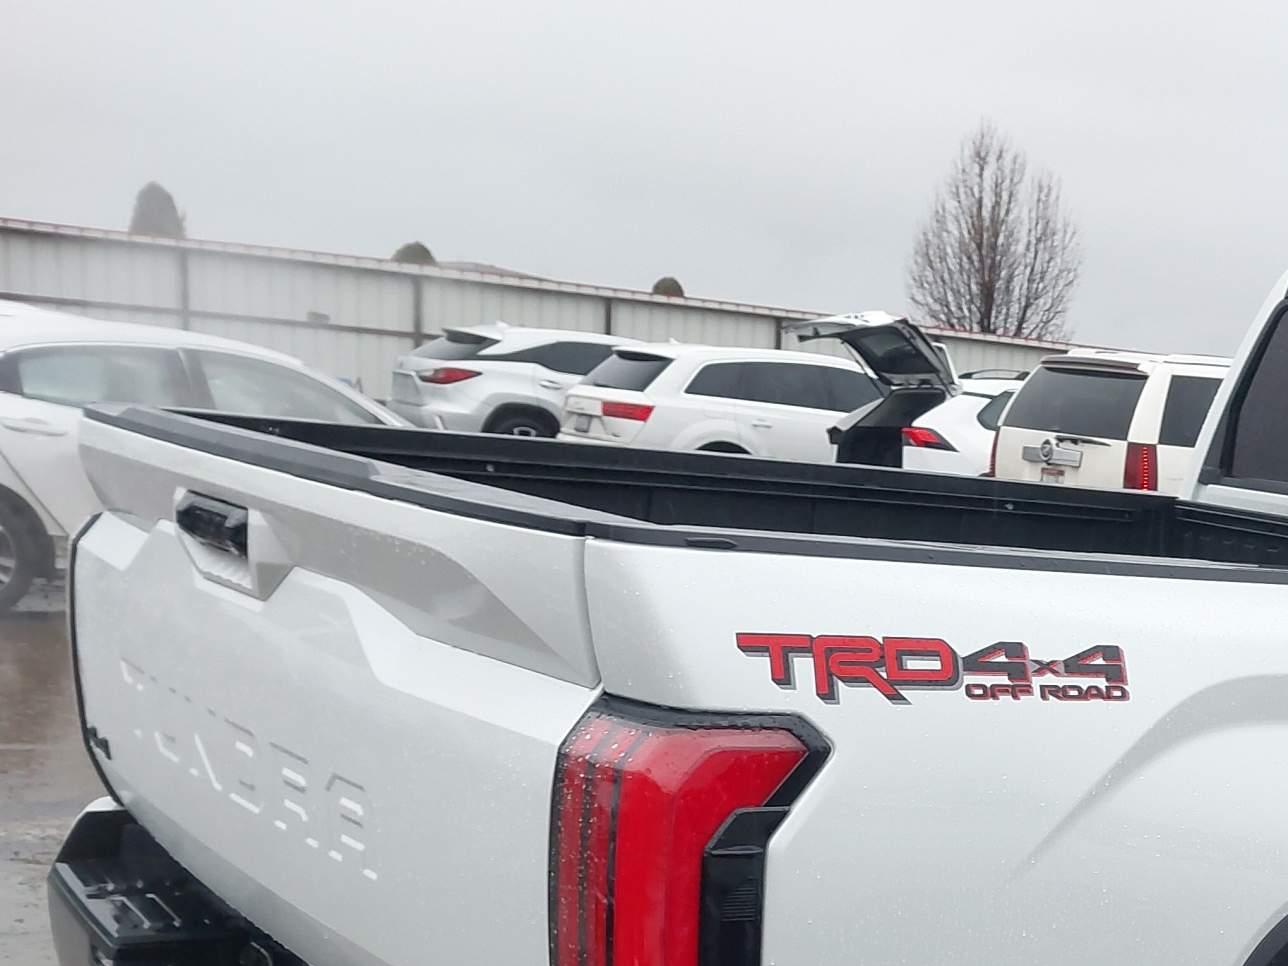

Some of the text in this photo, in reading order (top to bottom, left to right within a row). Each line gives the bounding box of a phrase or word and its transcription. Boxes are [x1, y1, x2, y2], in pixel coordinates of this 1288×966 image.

[736, 633, 962, 705] TRD
[965, 683, 1131, 702] OFF ROAD
